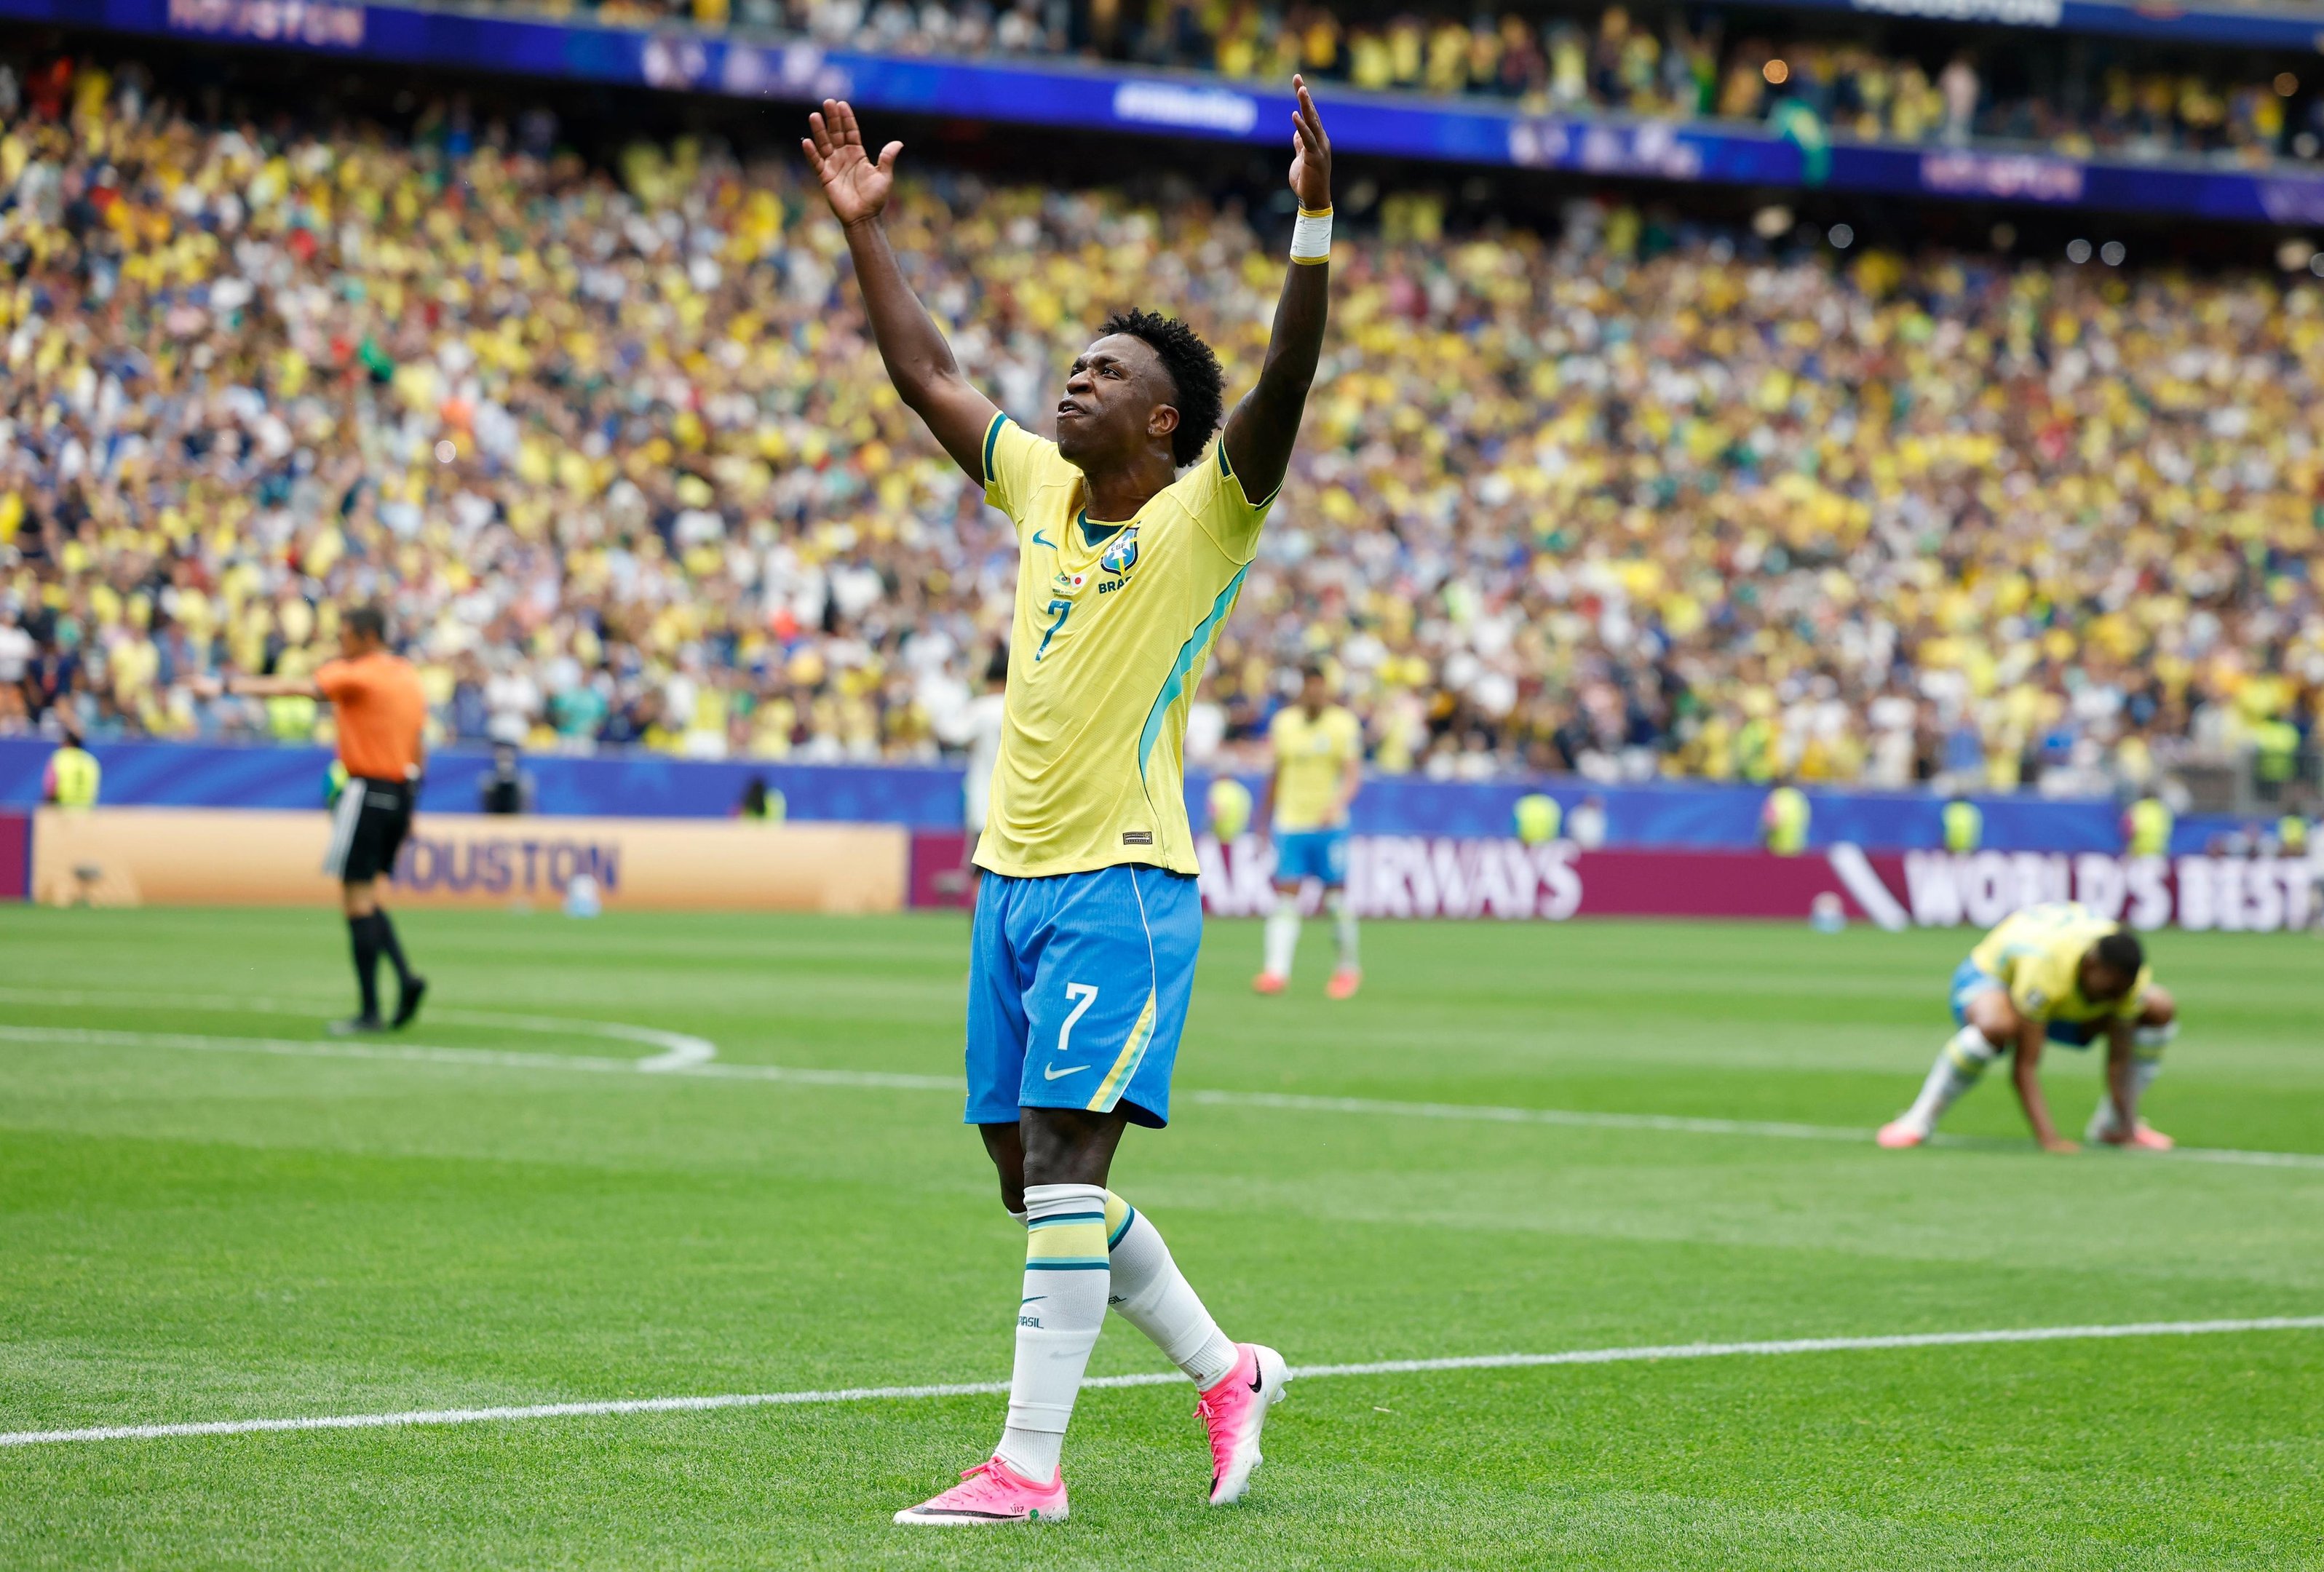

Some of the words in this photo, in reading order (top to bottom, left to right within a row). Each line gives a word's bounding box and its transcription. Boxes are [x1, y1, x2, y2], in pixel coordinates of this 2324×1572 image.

[1111, 542, 1126, 552] CBF
[1098, 576, 1132, 594] BRA
[1035, 599, 1072, 662] 7
[2176, 854, 2315, 934] BEST
[1058, 982, 1099, 1050] 7
[1018, 1315, 1044, 1330] RASIL
